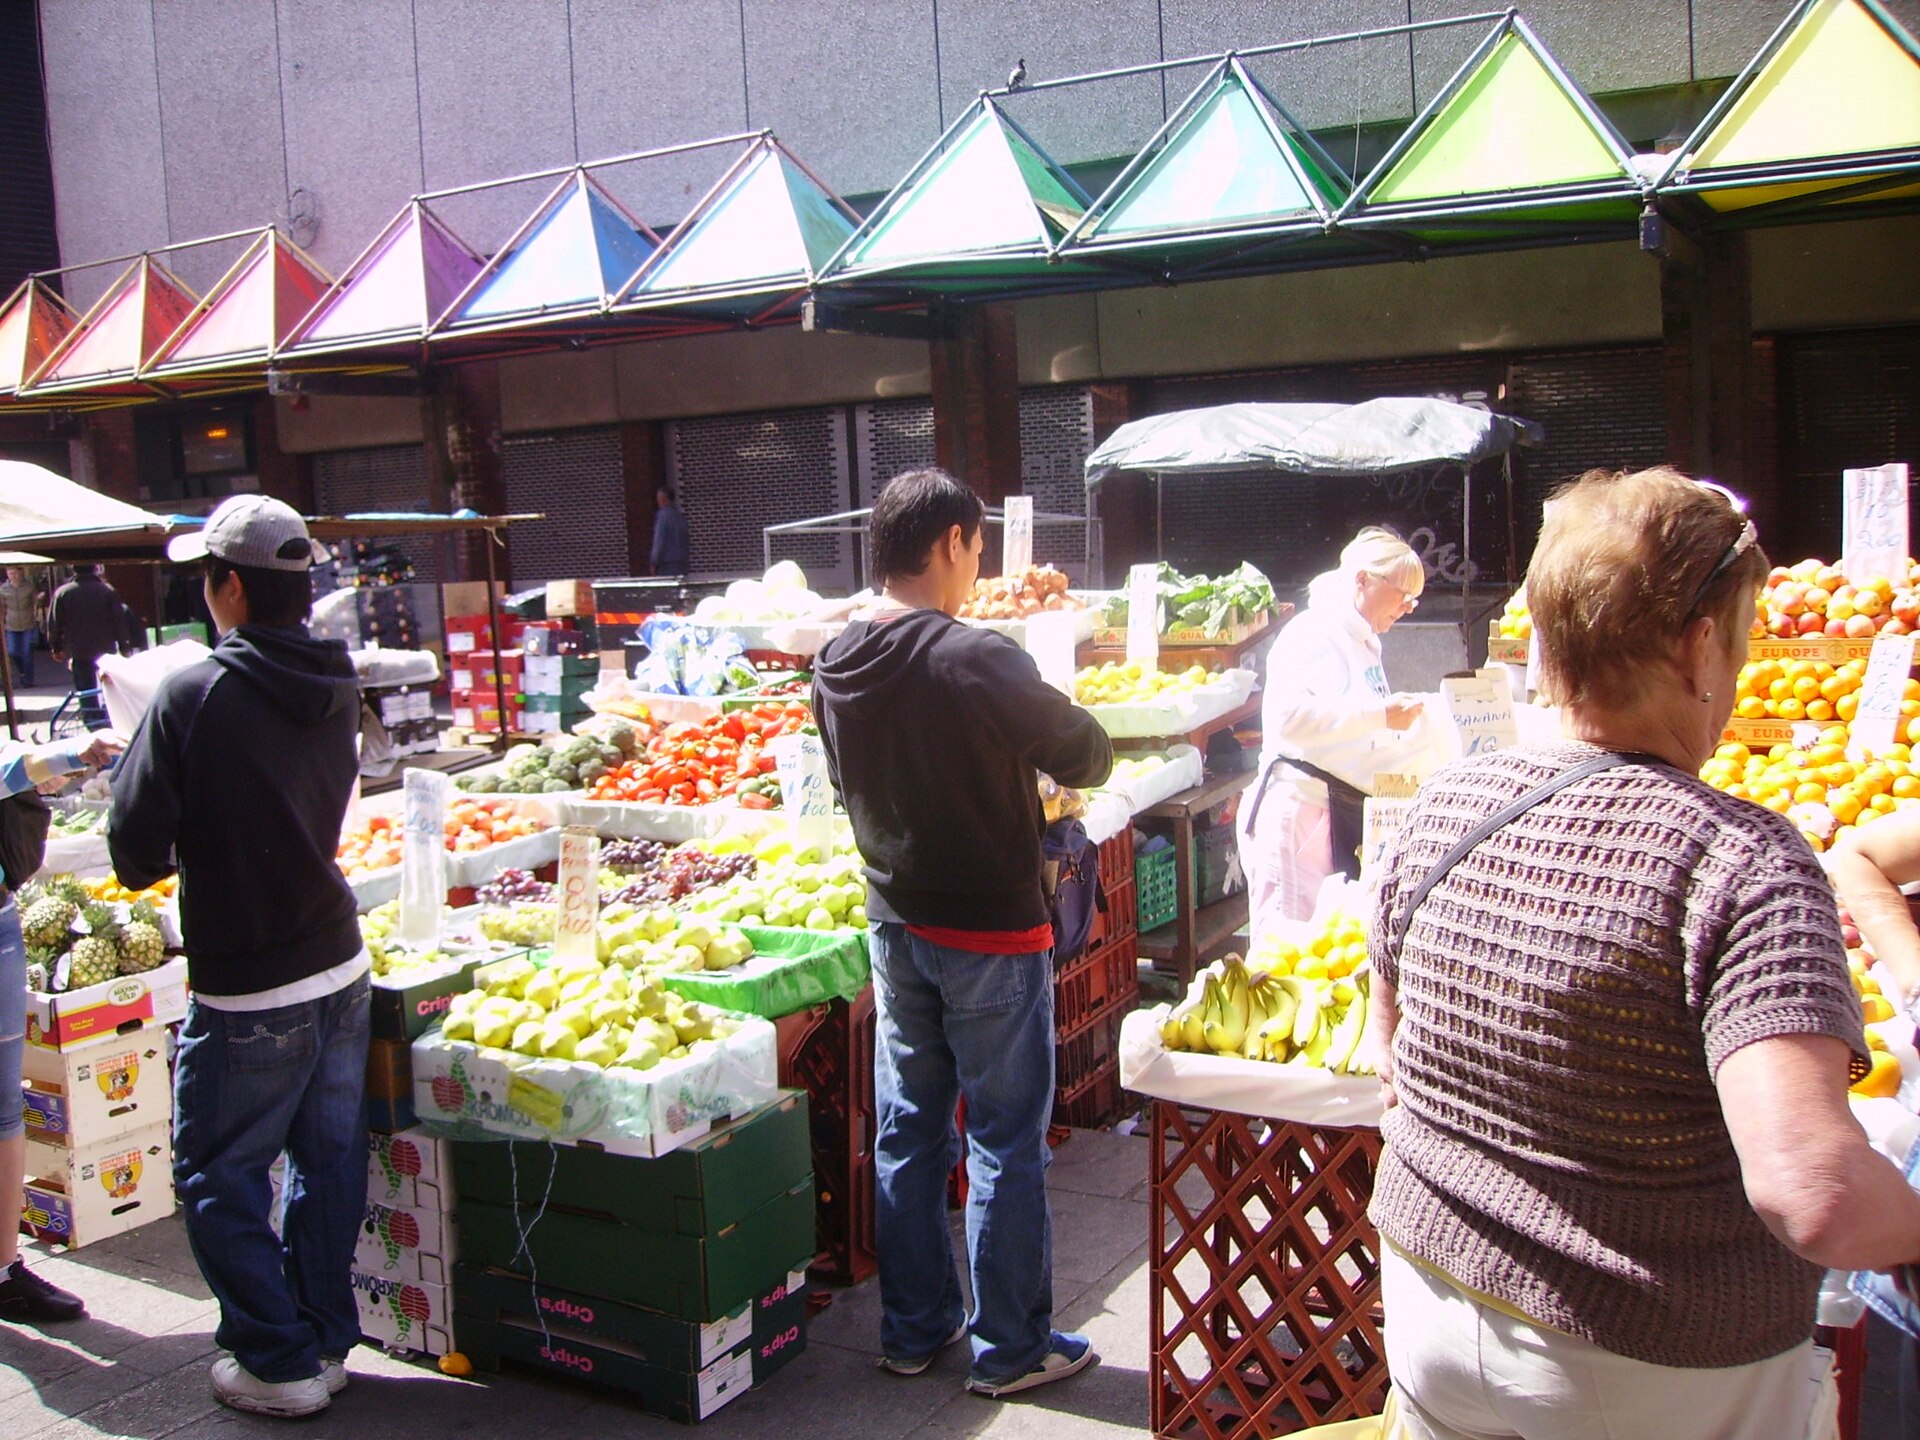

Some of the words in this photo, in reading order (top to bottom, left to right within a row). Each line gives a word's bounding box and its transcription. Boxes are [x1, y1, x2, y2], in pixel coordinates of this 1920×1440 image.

[1180, 630, 1226, 640] QUAY
[1761, 648, 1820, 658] EUROPE
[1454, 711, 1512, 728] BANANA
[1753, 728, 1795, 739] EURO
[113, 983, 139, 996] MAYAN
[540, 1297, 595, 1323] Crip's
[761, 1326, 799, 1357] Crip's
